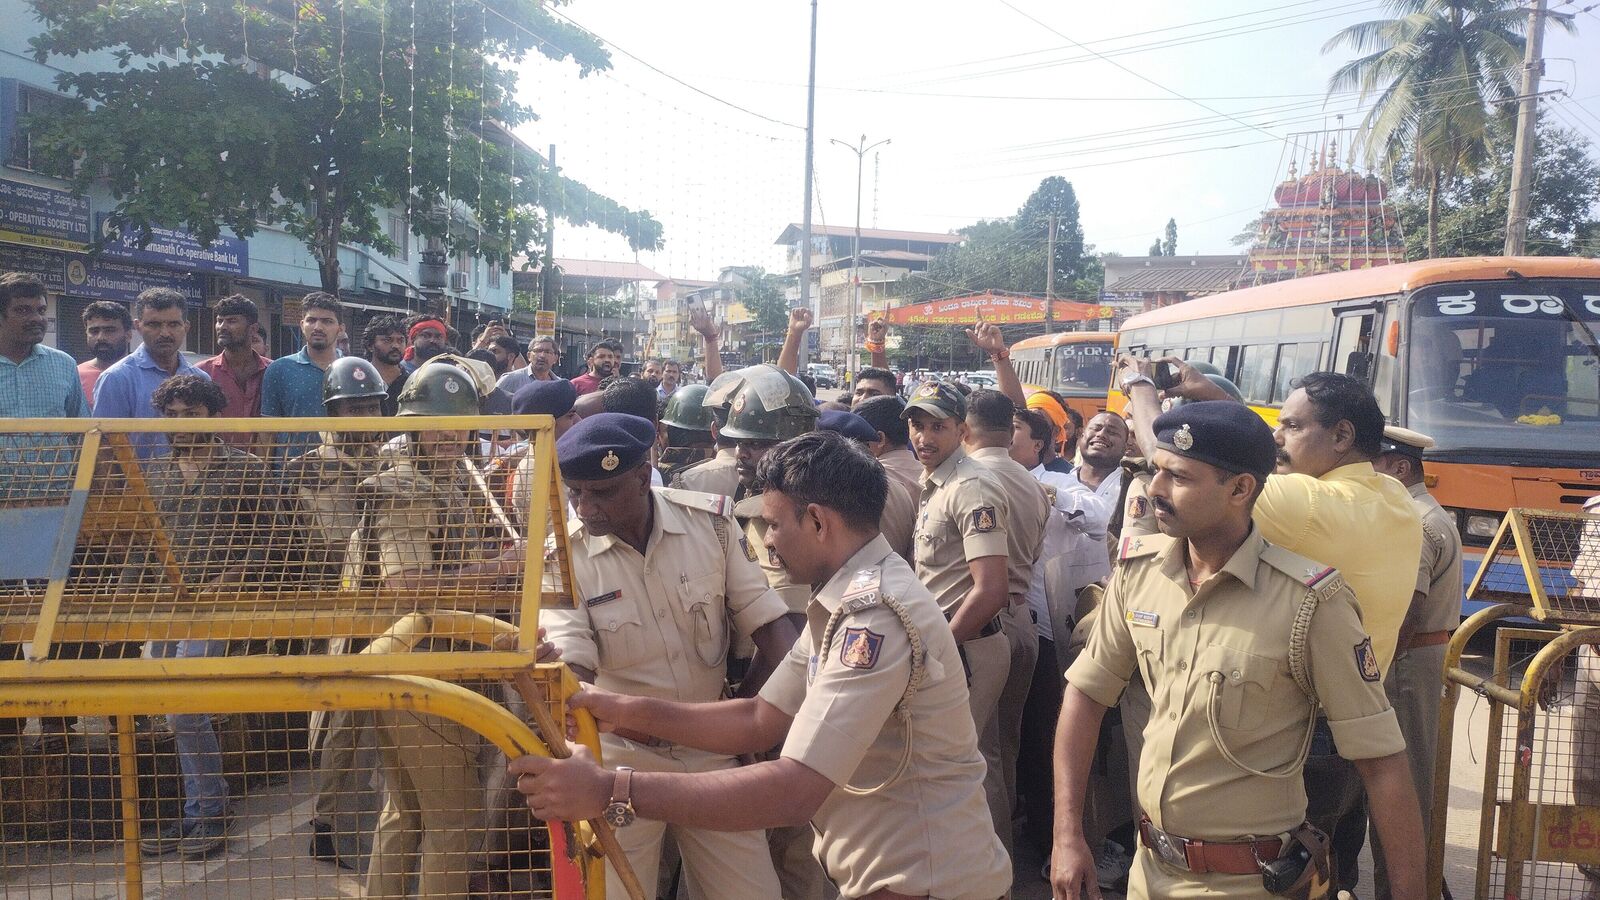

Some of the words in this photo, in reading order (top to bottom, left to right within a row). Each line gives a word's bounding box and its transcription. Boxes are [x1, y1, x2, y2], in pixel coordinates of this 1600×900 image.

[9, 211, 46, 226] OPERATIVE
[47, 217, 74, 231] SOCIETY
[74, 221, 88, 233] LTD.
[176, 245, 214, 261] Co-operative
[214, 251, 229, 264] Bank
[49, 274, 64, 282] LTD.
[86, 275, 97, 287] Sri
[97, 276, 139, 291] Gokarnanath
[192, 287, 203, 299] Ltd.
